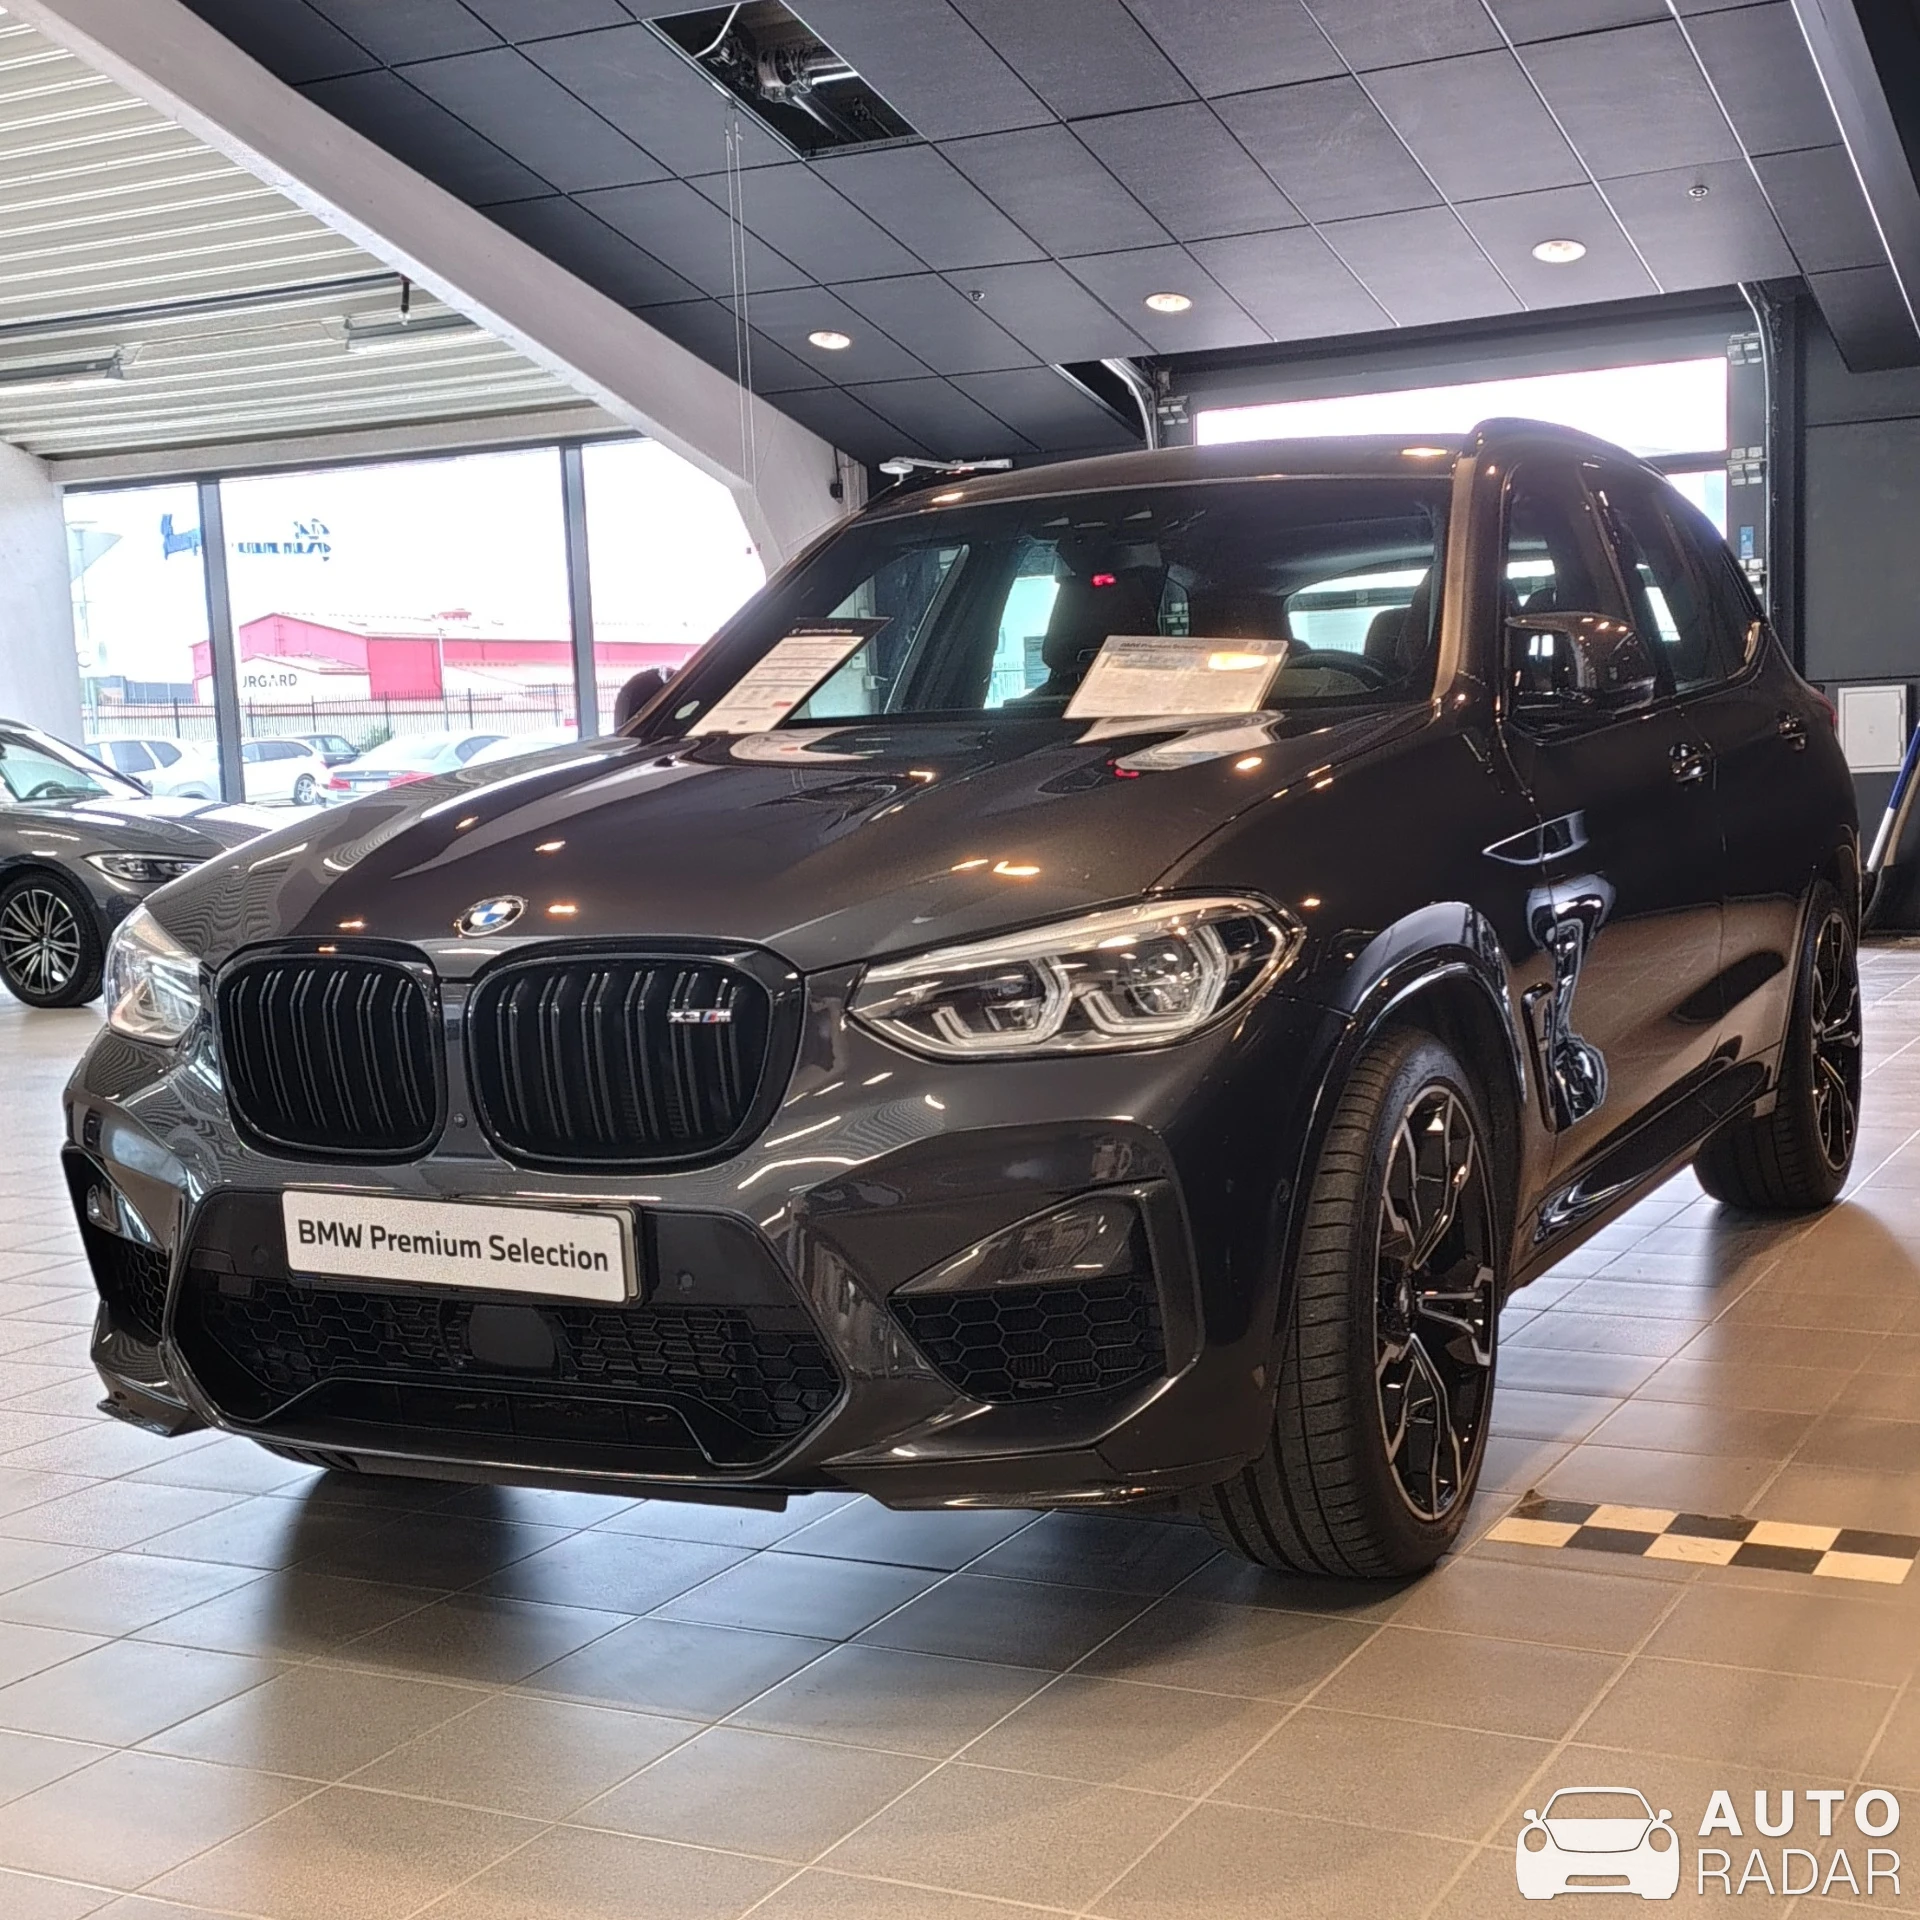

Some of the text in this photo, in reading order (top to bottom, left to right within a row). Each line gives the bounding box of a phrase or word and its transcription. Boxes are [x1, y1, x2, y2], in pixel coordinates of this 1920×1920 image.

[298, 1219, 609, 1272] BMW Premium Selection
